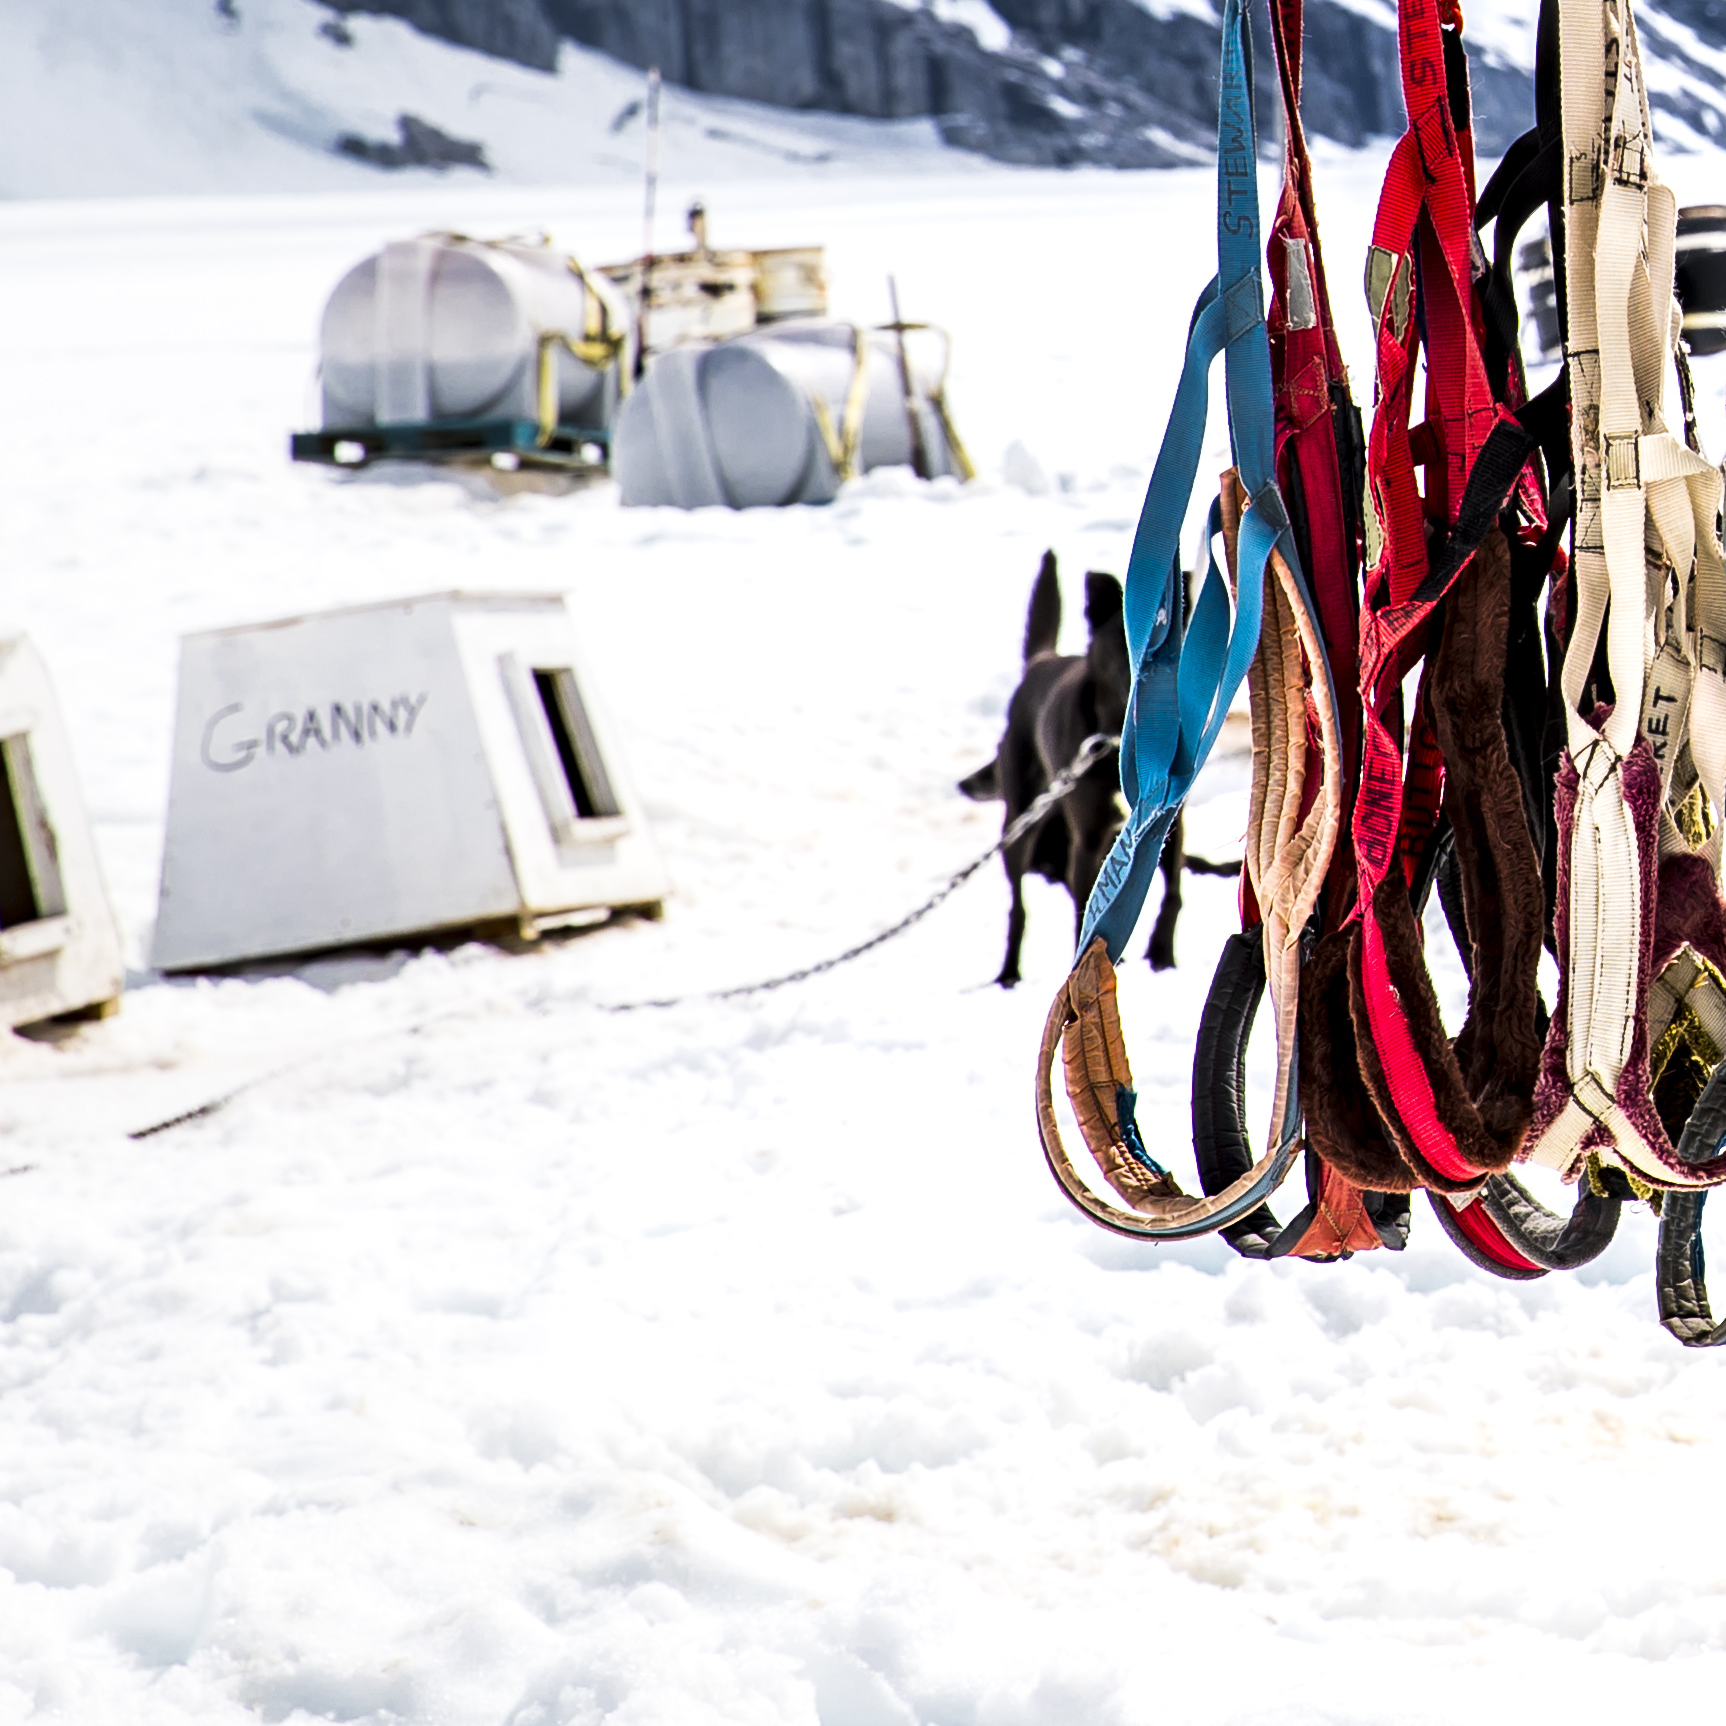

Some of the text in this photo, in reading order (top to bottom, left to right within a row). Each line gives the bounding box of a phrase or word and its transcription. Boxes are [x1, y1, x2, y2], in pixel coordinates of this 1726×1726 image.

[1221, 40, 1255, 241] STEWART
[200, 691, 430, 774] GRANNY
[1647, 684, 1680, 775] KET
[1079, 827, 1135, 947] RMAN
